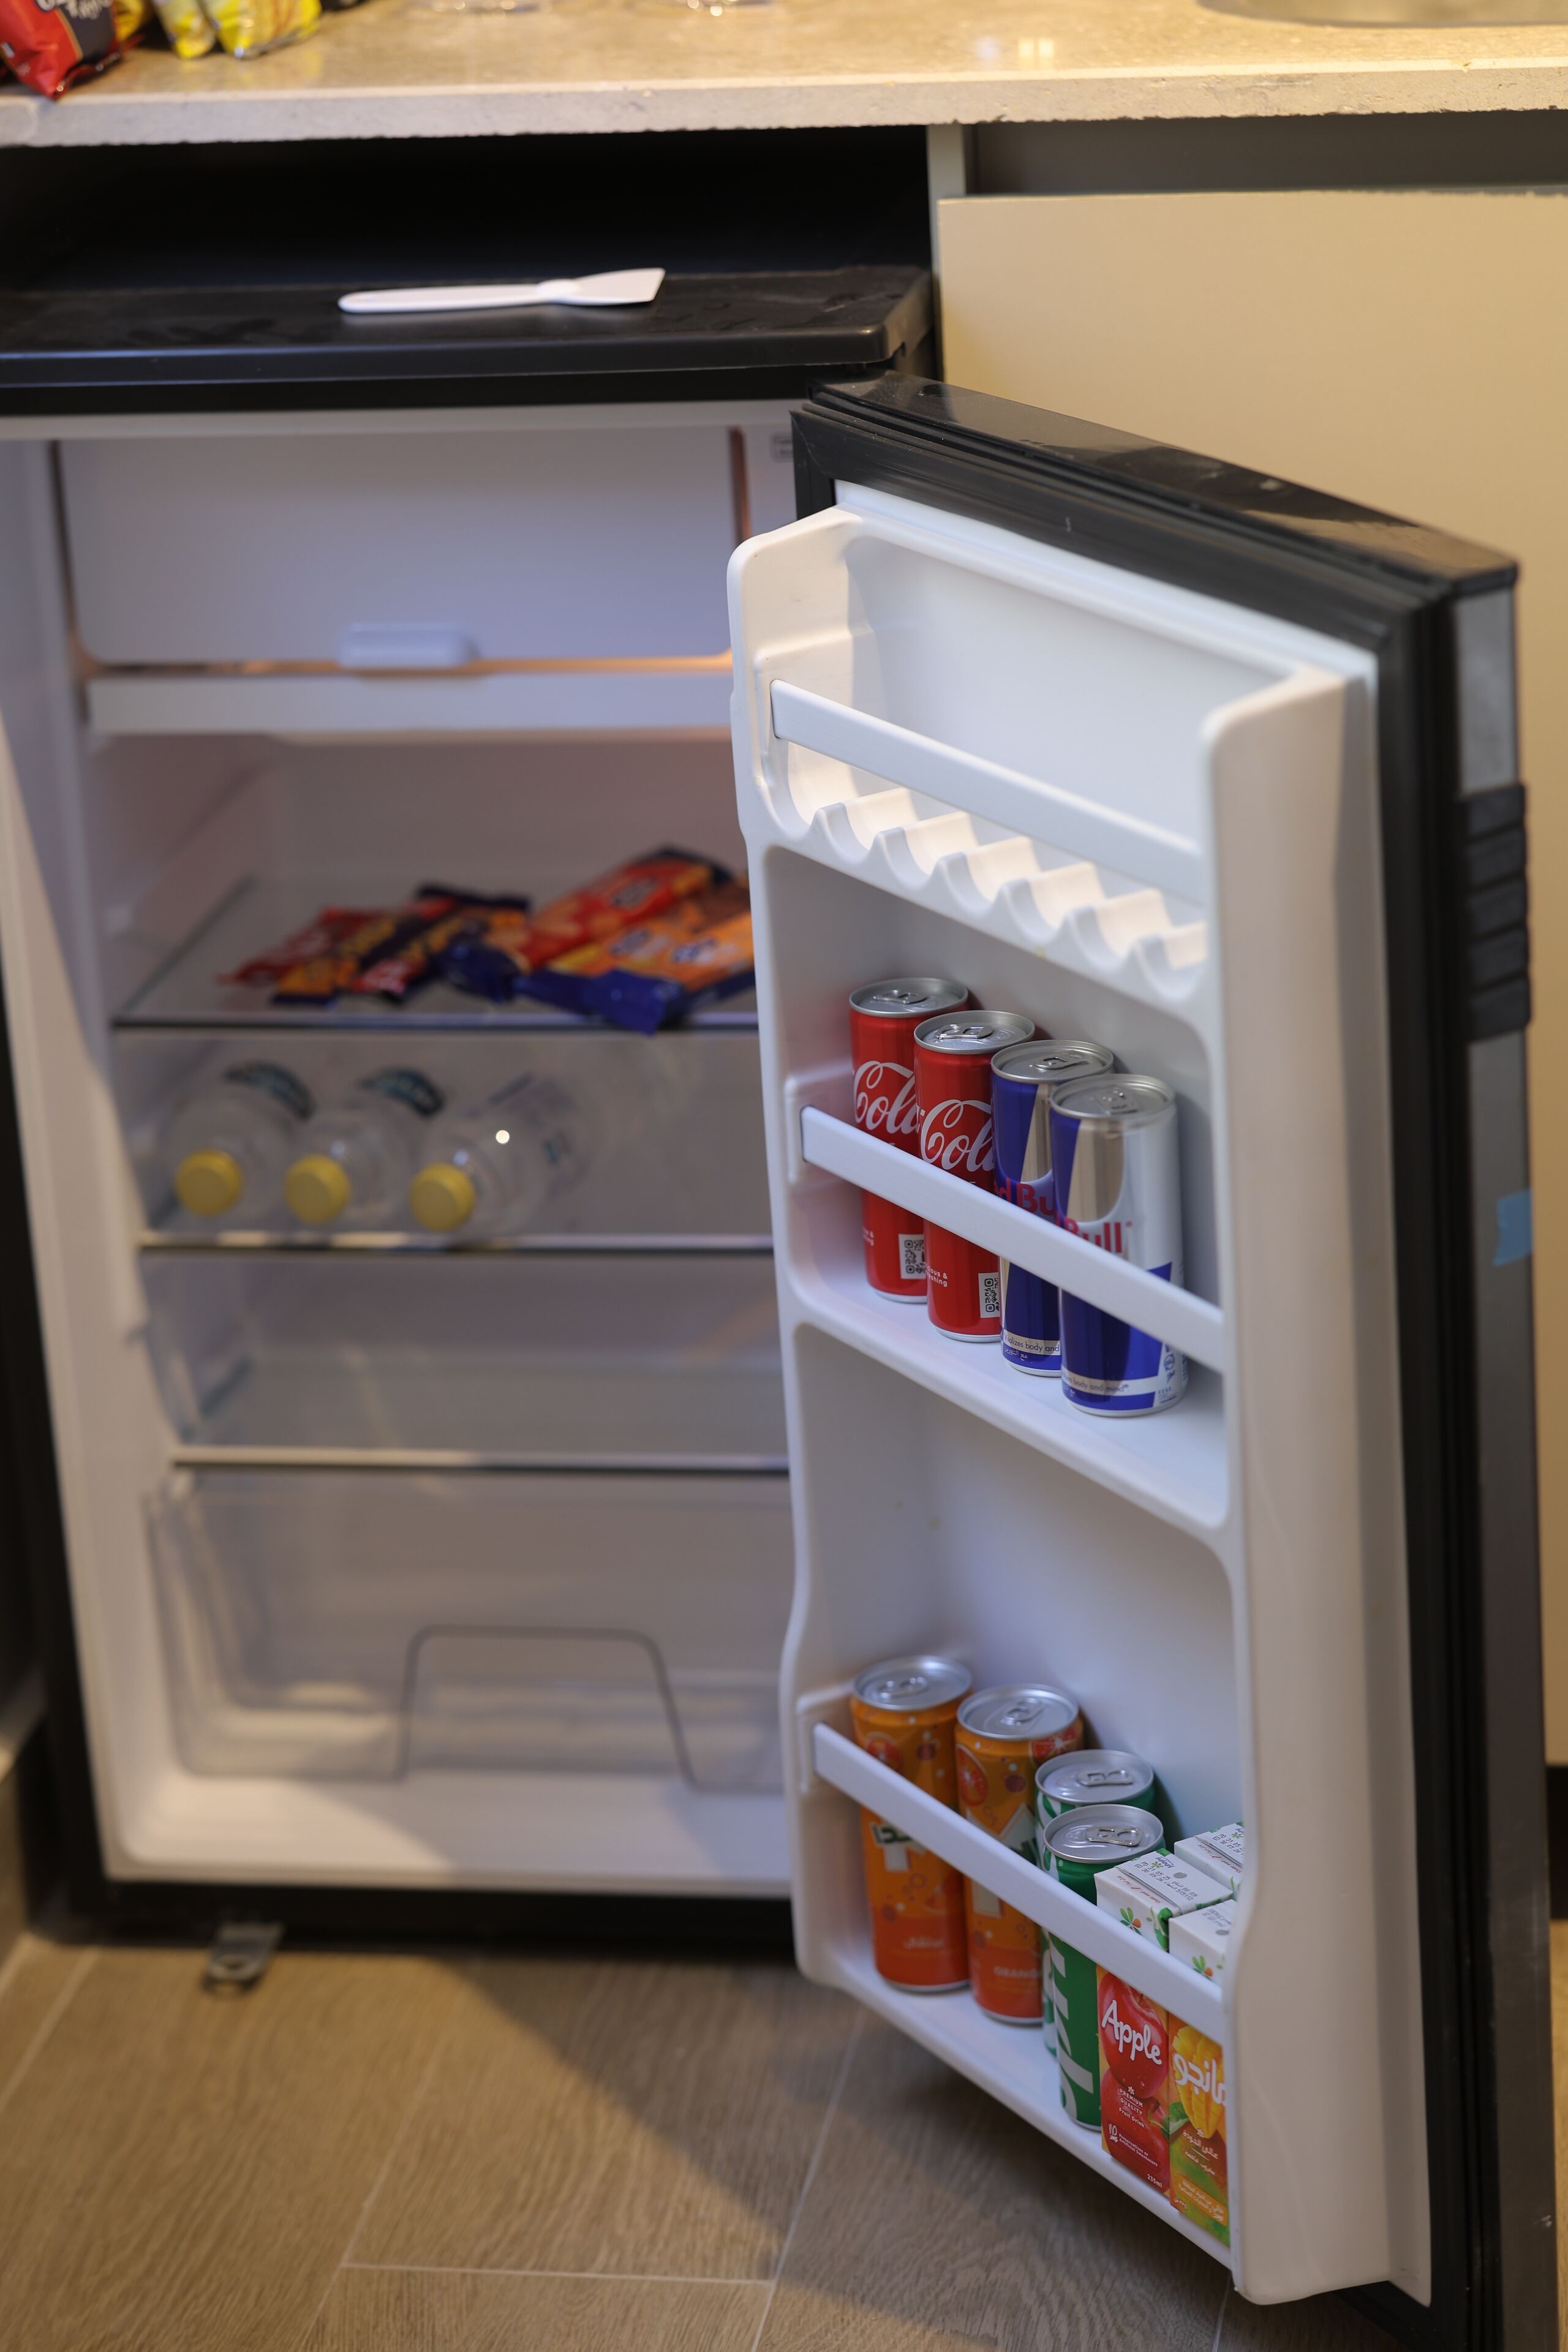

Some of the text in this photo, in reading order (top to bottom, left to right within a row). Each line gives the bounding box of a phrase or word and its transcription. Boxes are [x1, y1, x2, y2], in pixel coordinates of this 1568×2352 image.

[1025, 1341, 1042, 1353] body
[1102, 1999, 1163, 2065] Apple
[1120, 2089, 1143, 2107] PREMIUM
[1121, 2097, 1142, 2115] QUALITY
[1119, 2107, 1145, 2128] Fruit Drink
[1119, 2133, 1144, 2153] Preservatives
[1119, 2138, 1158, 2166] Artificial Sweeteners
[1147, 2174, 1163, 2188] 235ml
